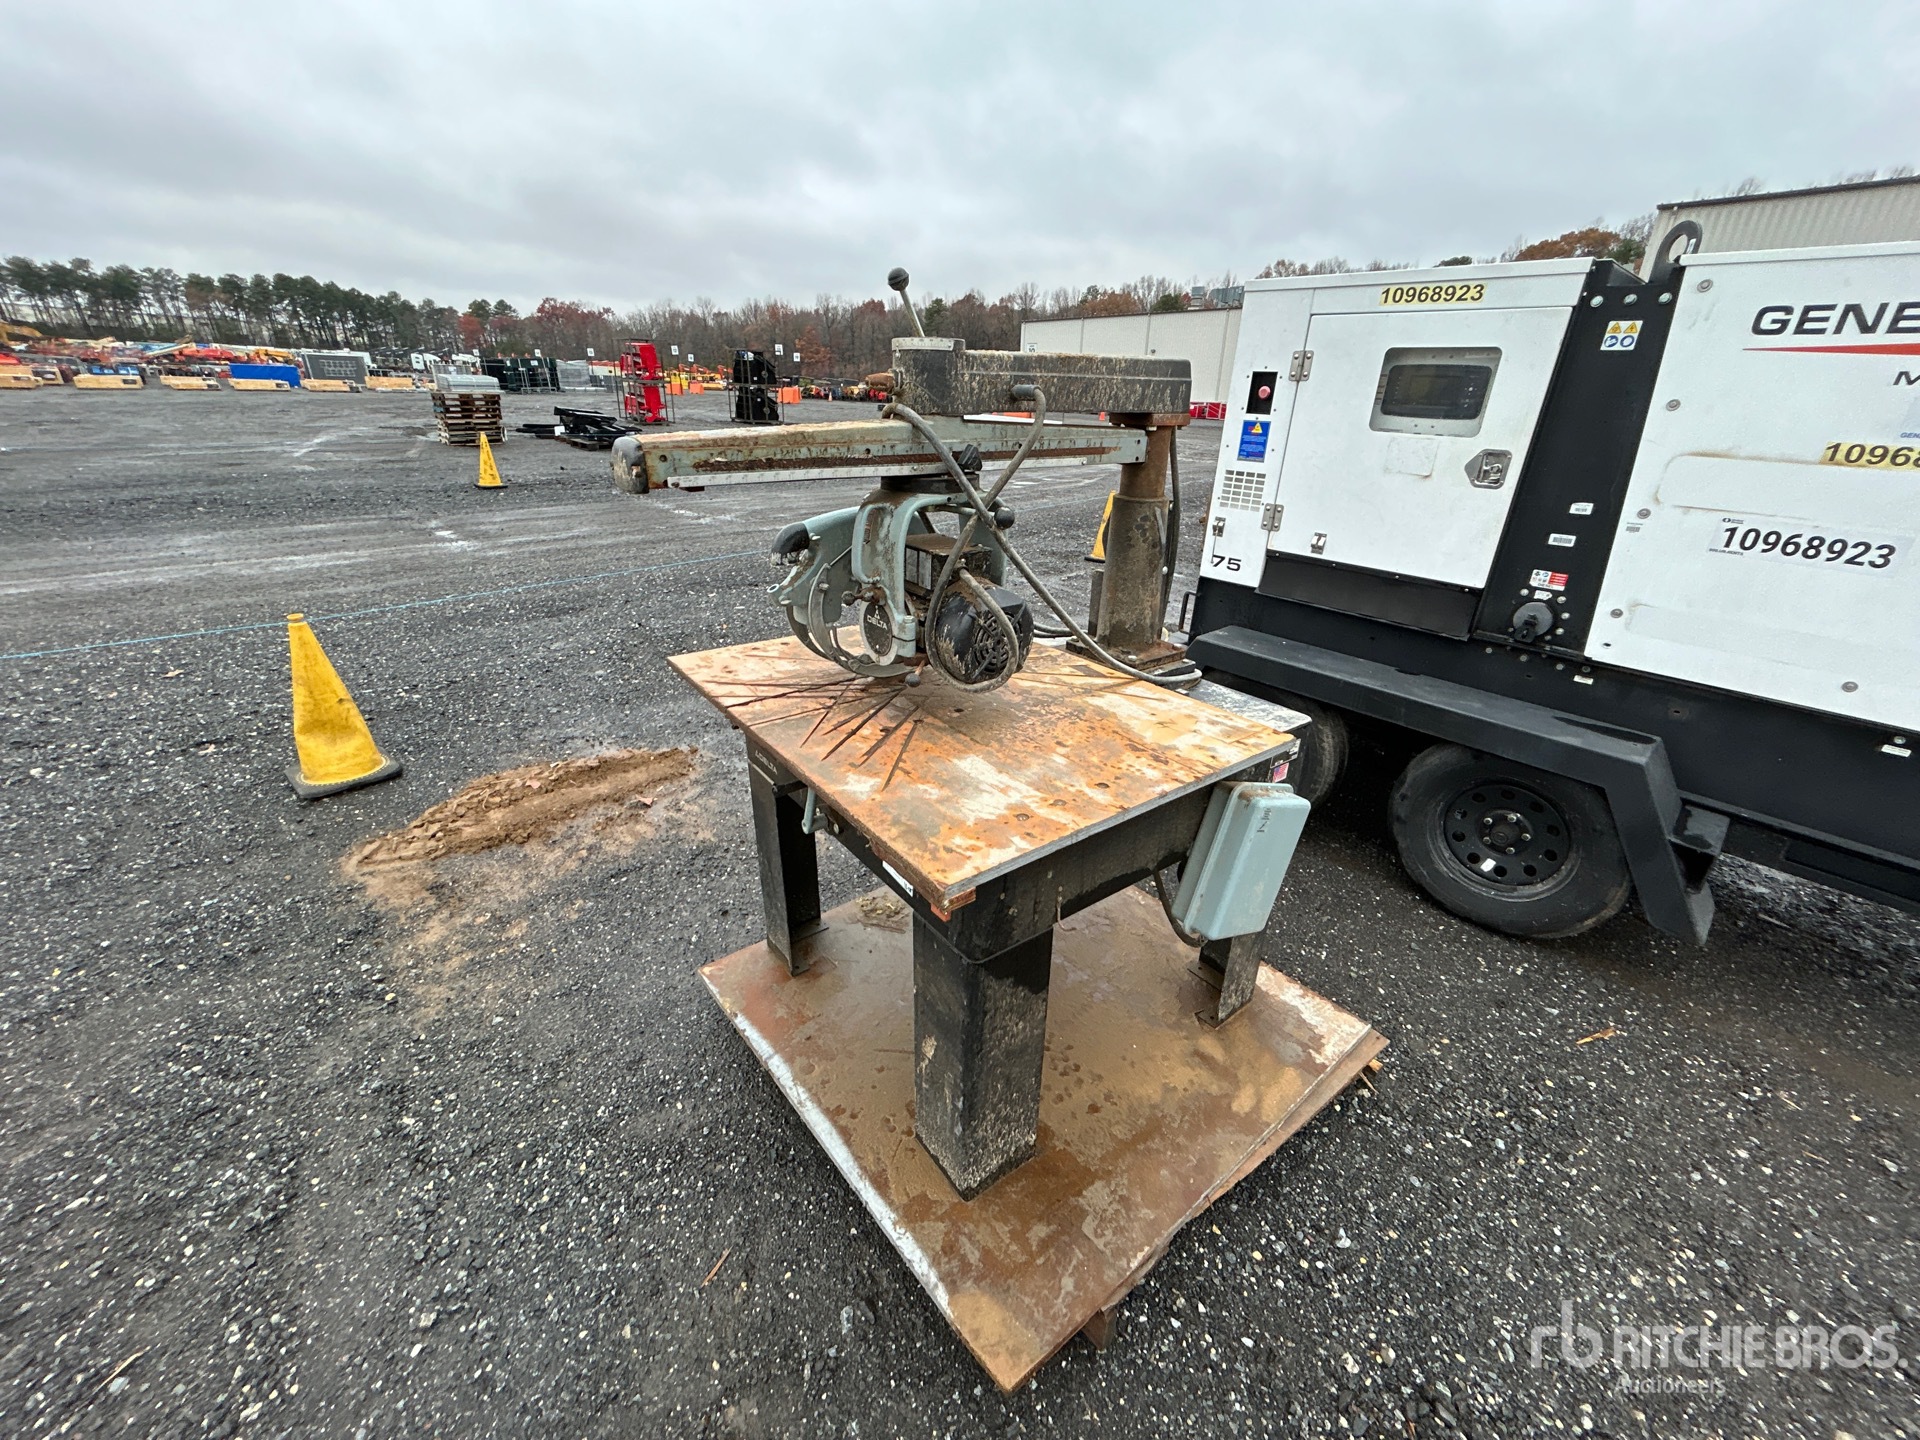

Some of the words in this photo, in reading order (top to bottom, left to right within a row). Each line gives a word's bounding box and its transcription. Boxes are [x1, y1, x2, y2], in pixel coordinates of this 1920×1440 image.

[1381, 284, 1485, 304] 10968923
[1751, 302, 1920, 335] GENE
[1723, 526, 1896, 569] 10968923
[1212, 555, 1241, 572] 75
[867, 614, 888, 630] DELTA
